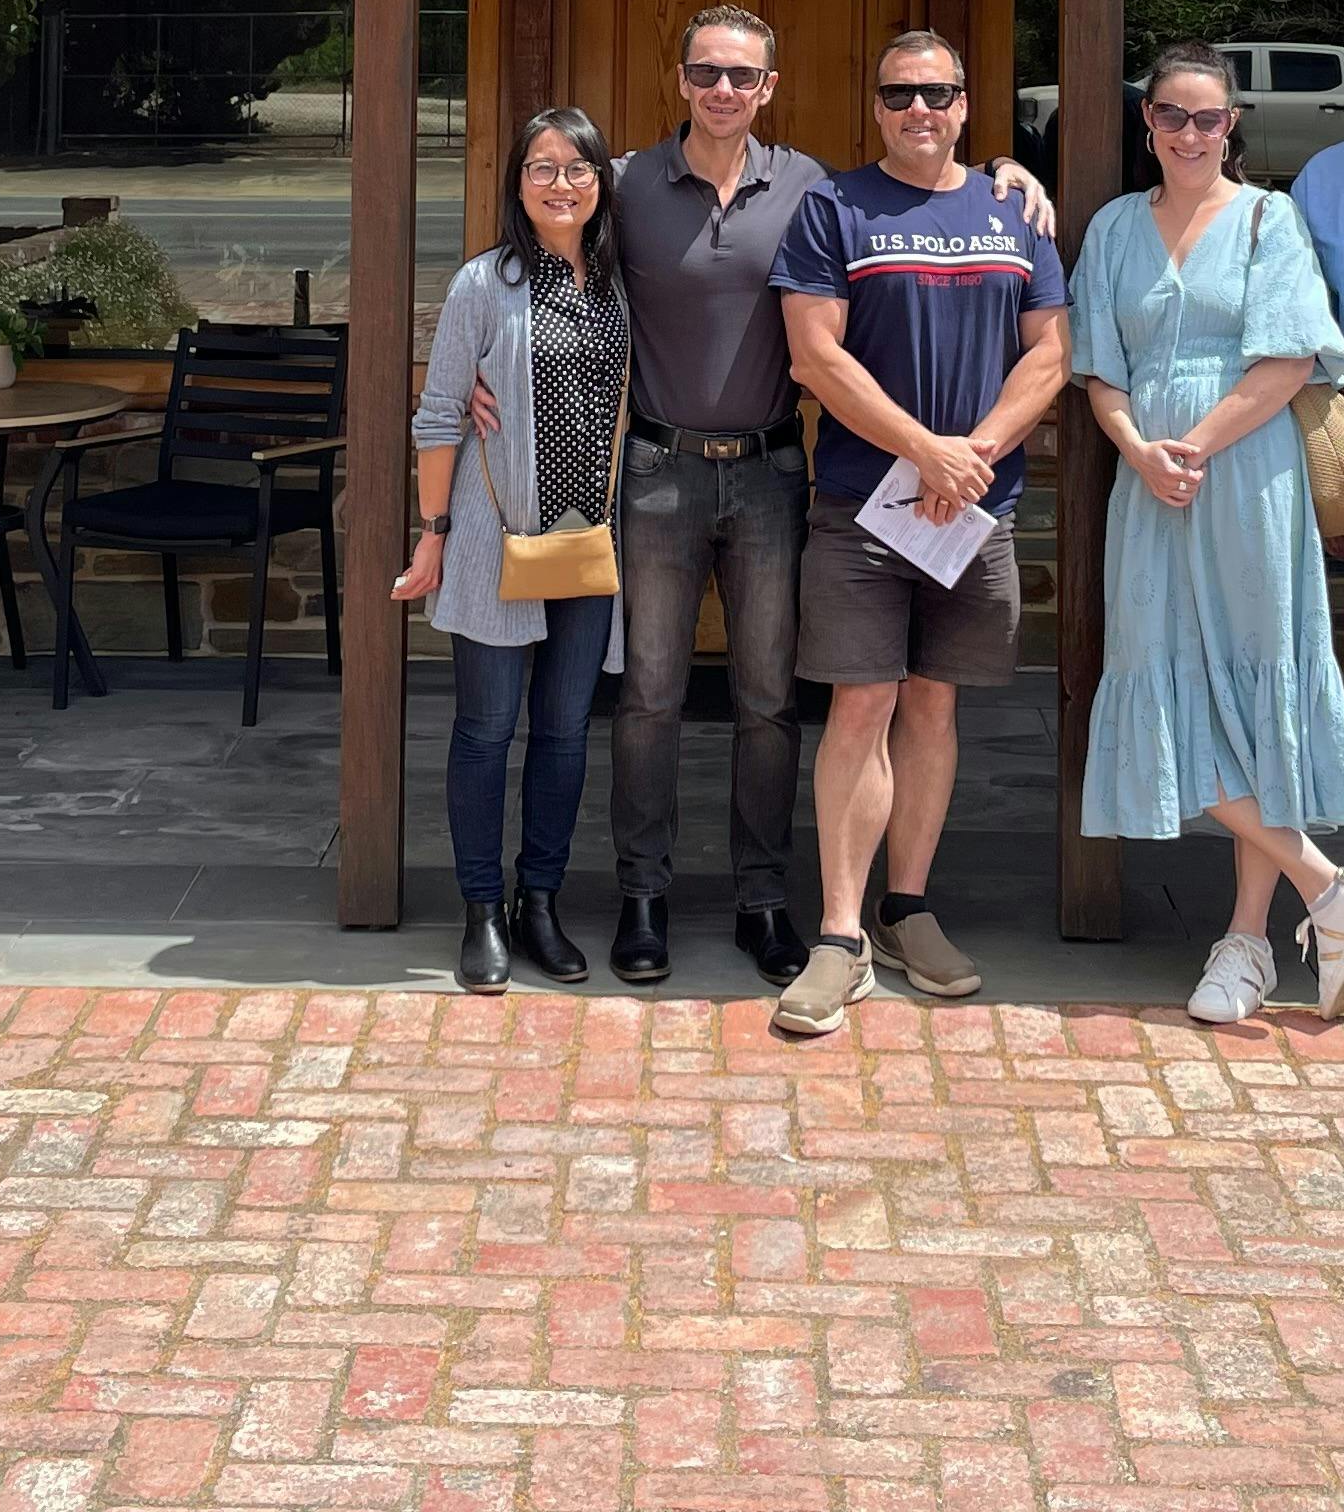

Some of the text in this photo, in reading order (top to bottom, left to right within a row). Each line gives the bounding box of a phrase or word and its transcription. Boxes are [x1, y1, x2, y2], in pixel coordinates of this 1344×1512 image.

[870, 234, 1020, 254] U.S. POLO ASSN.
[917, 273, 984, 287] SINCE 1890
